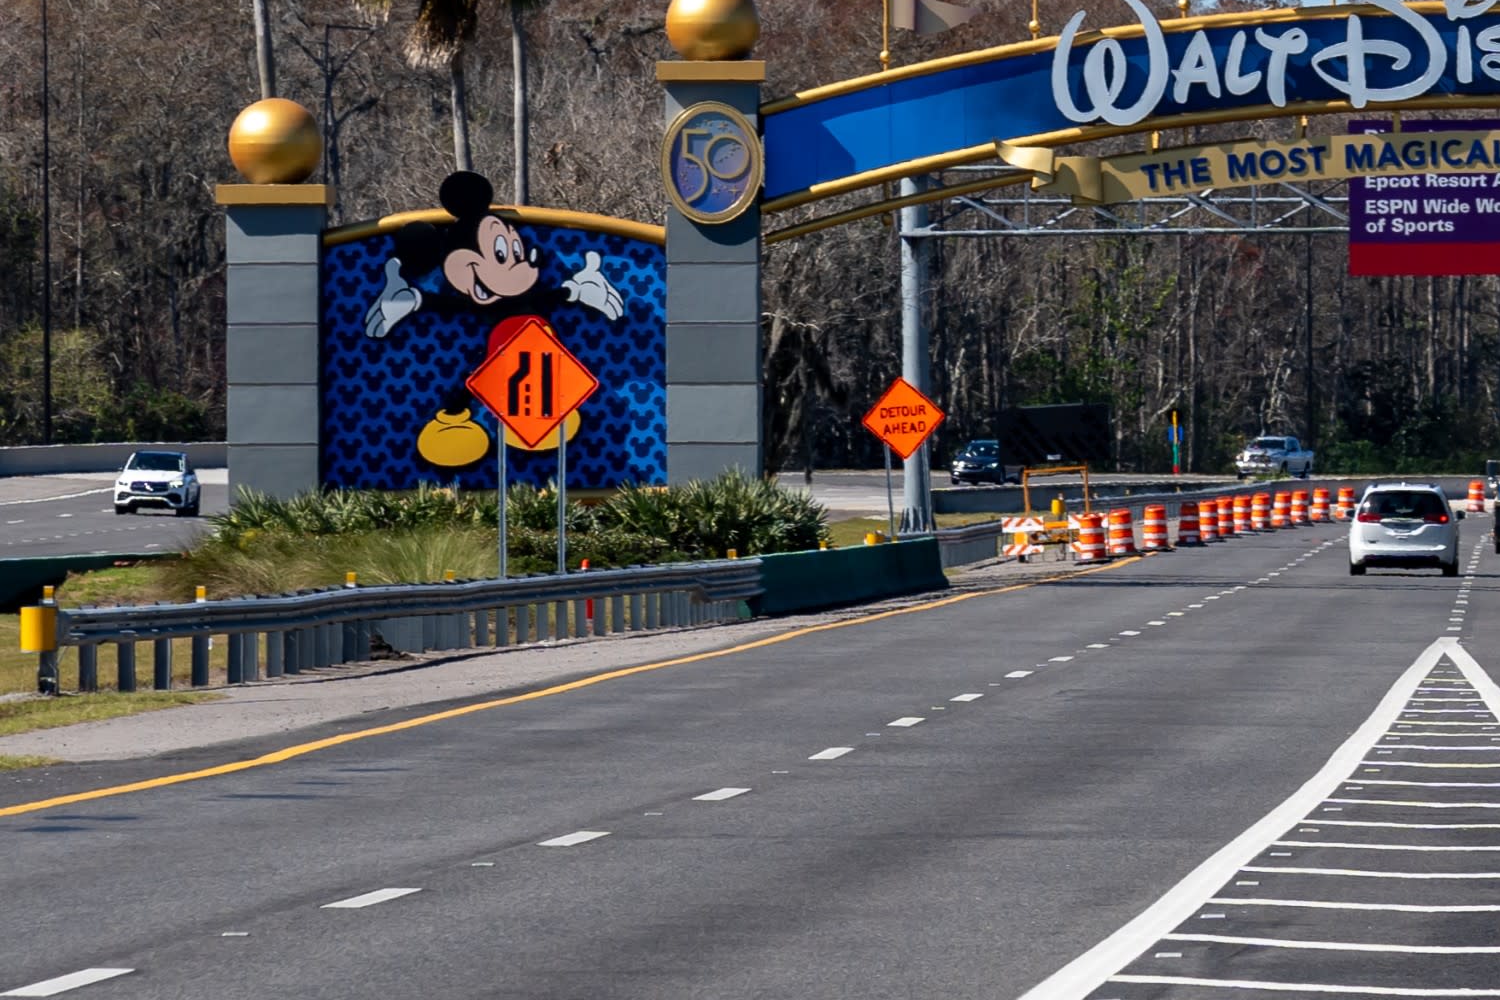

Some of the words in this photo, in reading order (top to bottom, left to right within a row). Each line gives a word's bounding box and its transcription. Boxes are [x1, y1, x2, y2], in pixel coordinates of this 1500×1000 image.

[681, 128, 750, 204] 50
[1139, 157, 1212, 191] THE
[1225, 145, 1327, 181] MOST
[1364, 174, 1420, 191] Epcot
[1426, 173, 1487, 188] Resort
[1364, 199, 1418, 215] ESPN
[1423, 198, 1470, 214] Wide
[1365, 218, 1387, 233] of
[1391, 217, 1455, 236] Sports
[880, 404, 927, 419] DETOUR
[883, 420, 927, 436] AHEAD
